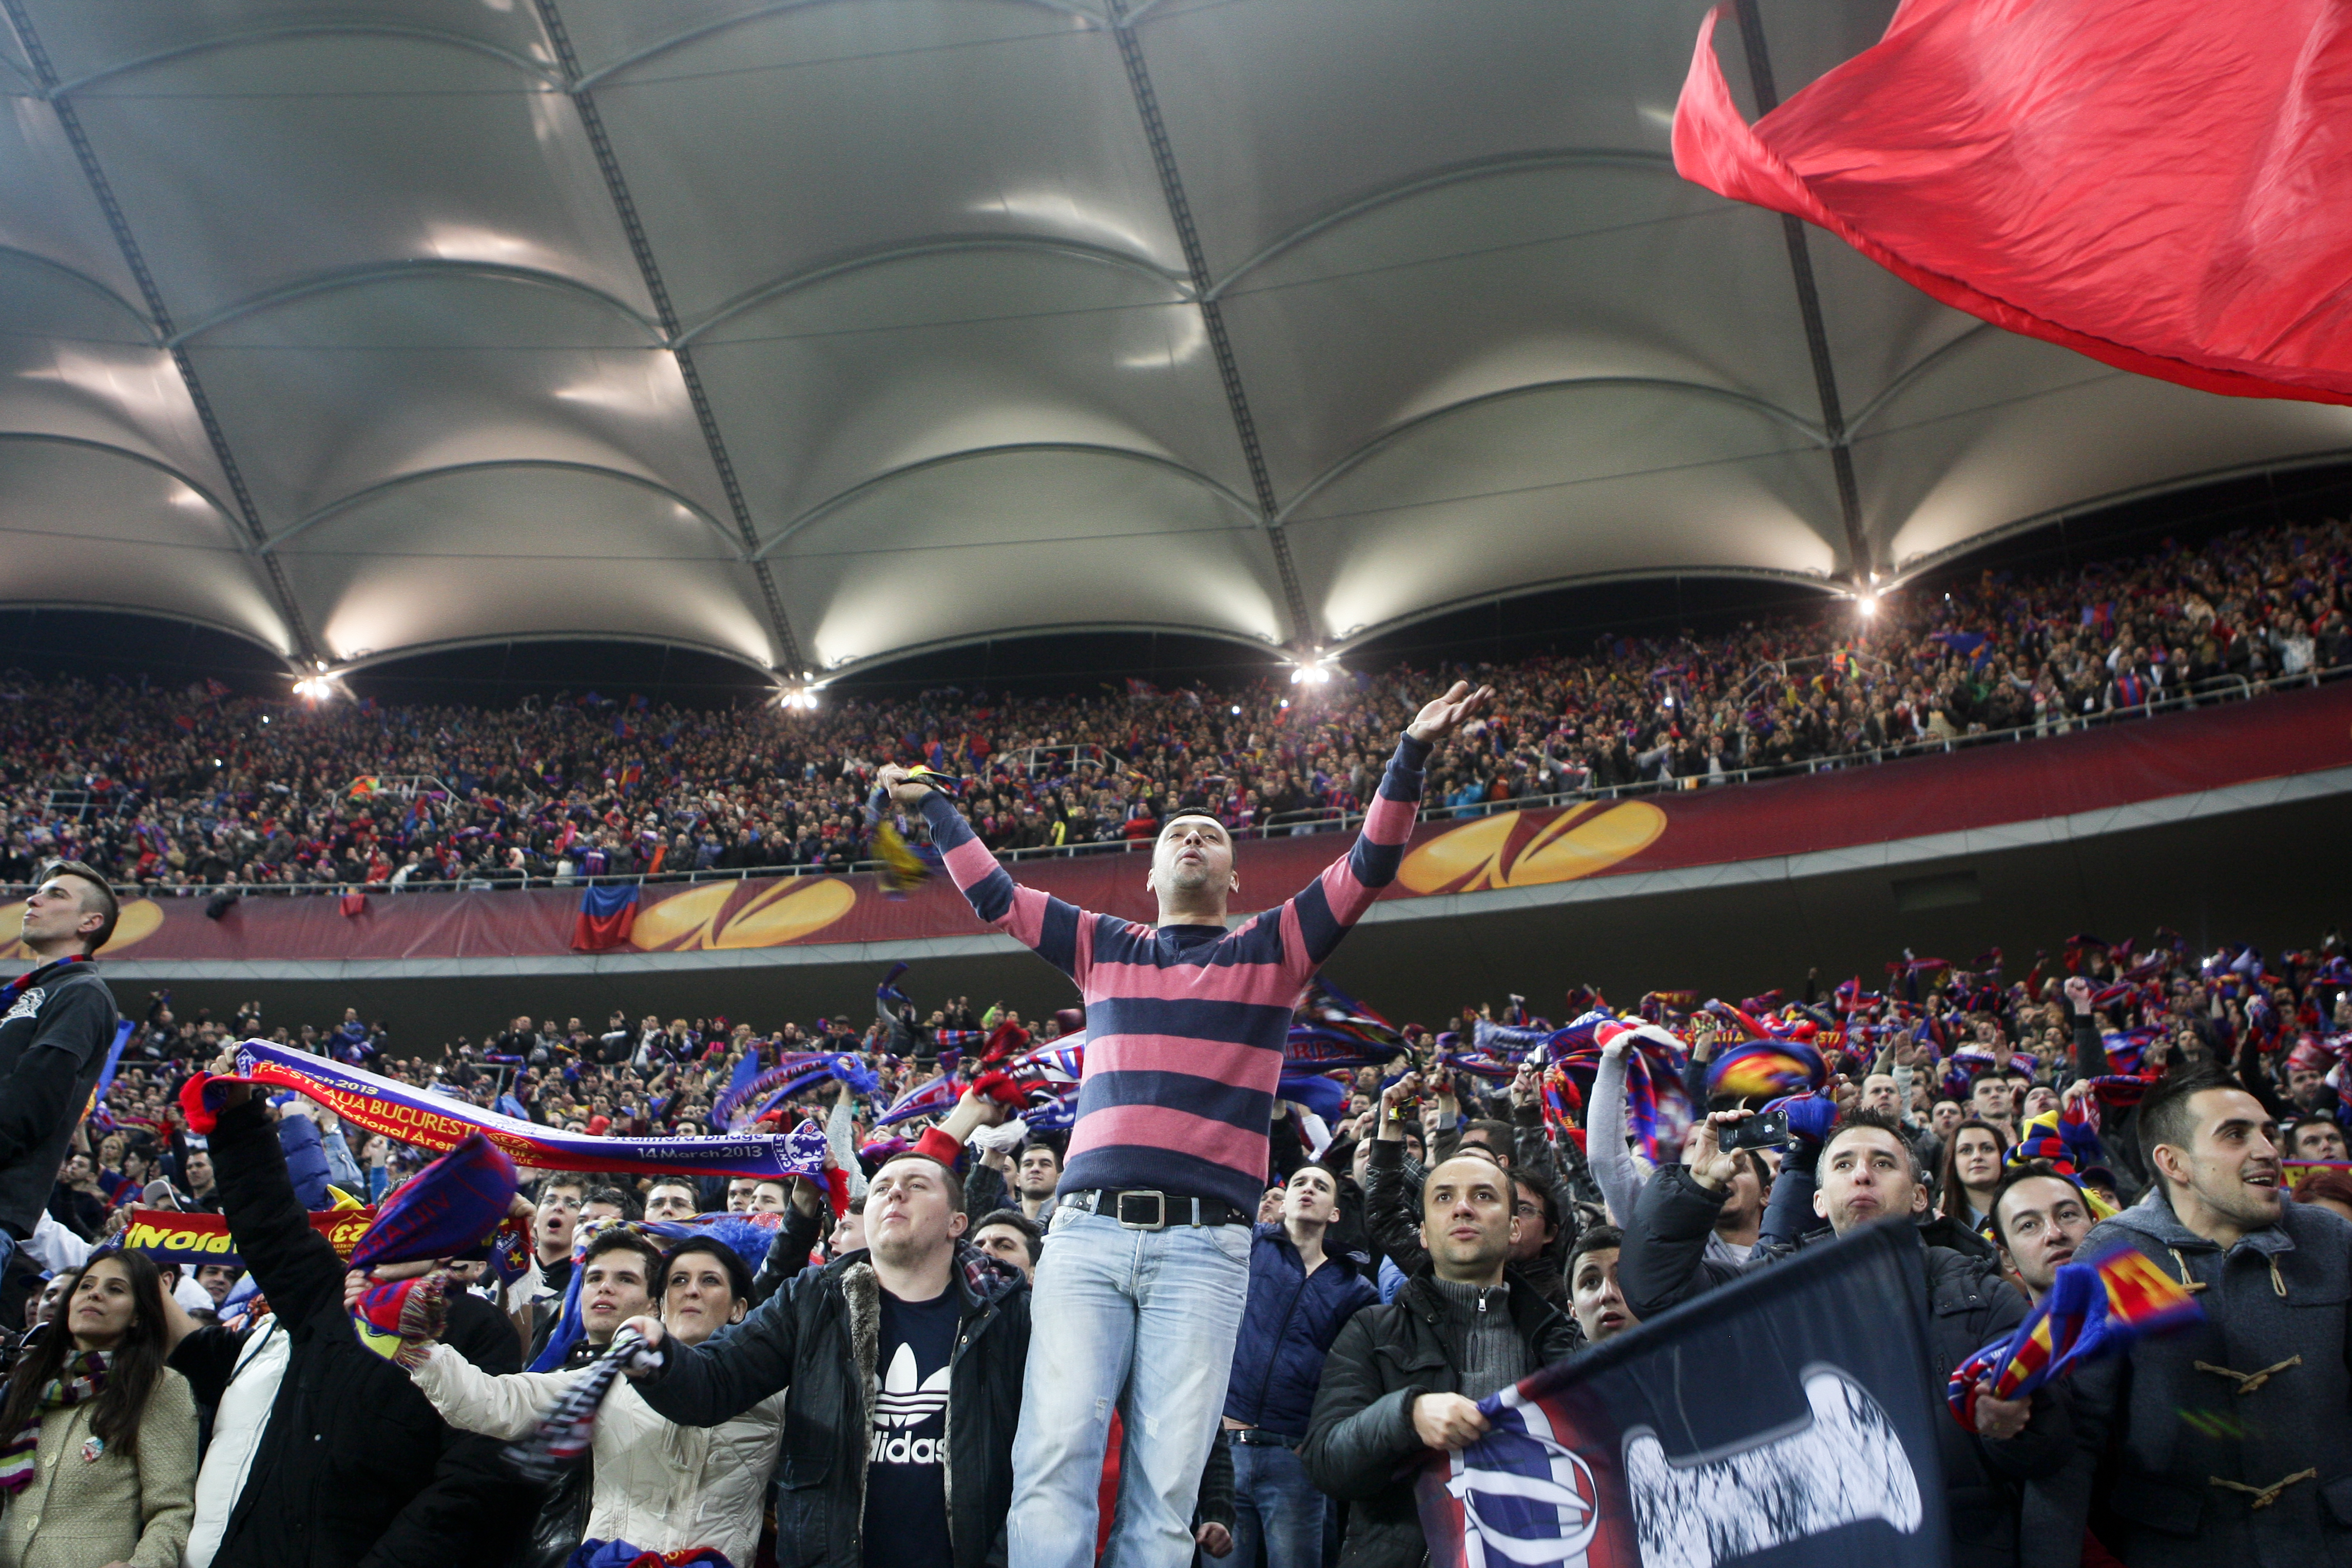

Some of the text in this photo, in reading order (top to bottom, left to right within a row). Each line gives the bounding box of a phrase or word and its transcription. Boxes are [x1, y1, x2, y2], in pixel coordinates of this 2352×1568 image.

[335, 1079, 379, 1095] 2013
[410, 1130, 457, 1151] Aren
[638, 1145, 764, 1158] 14 March 2013
